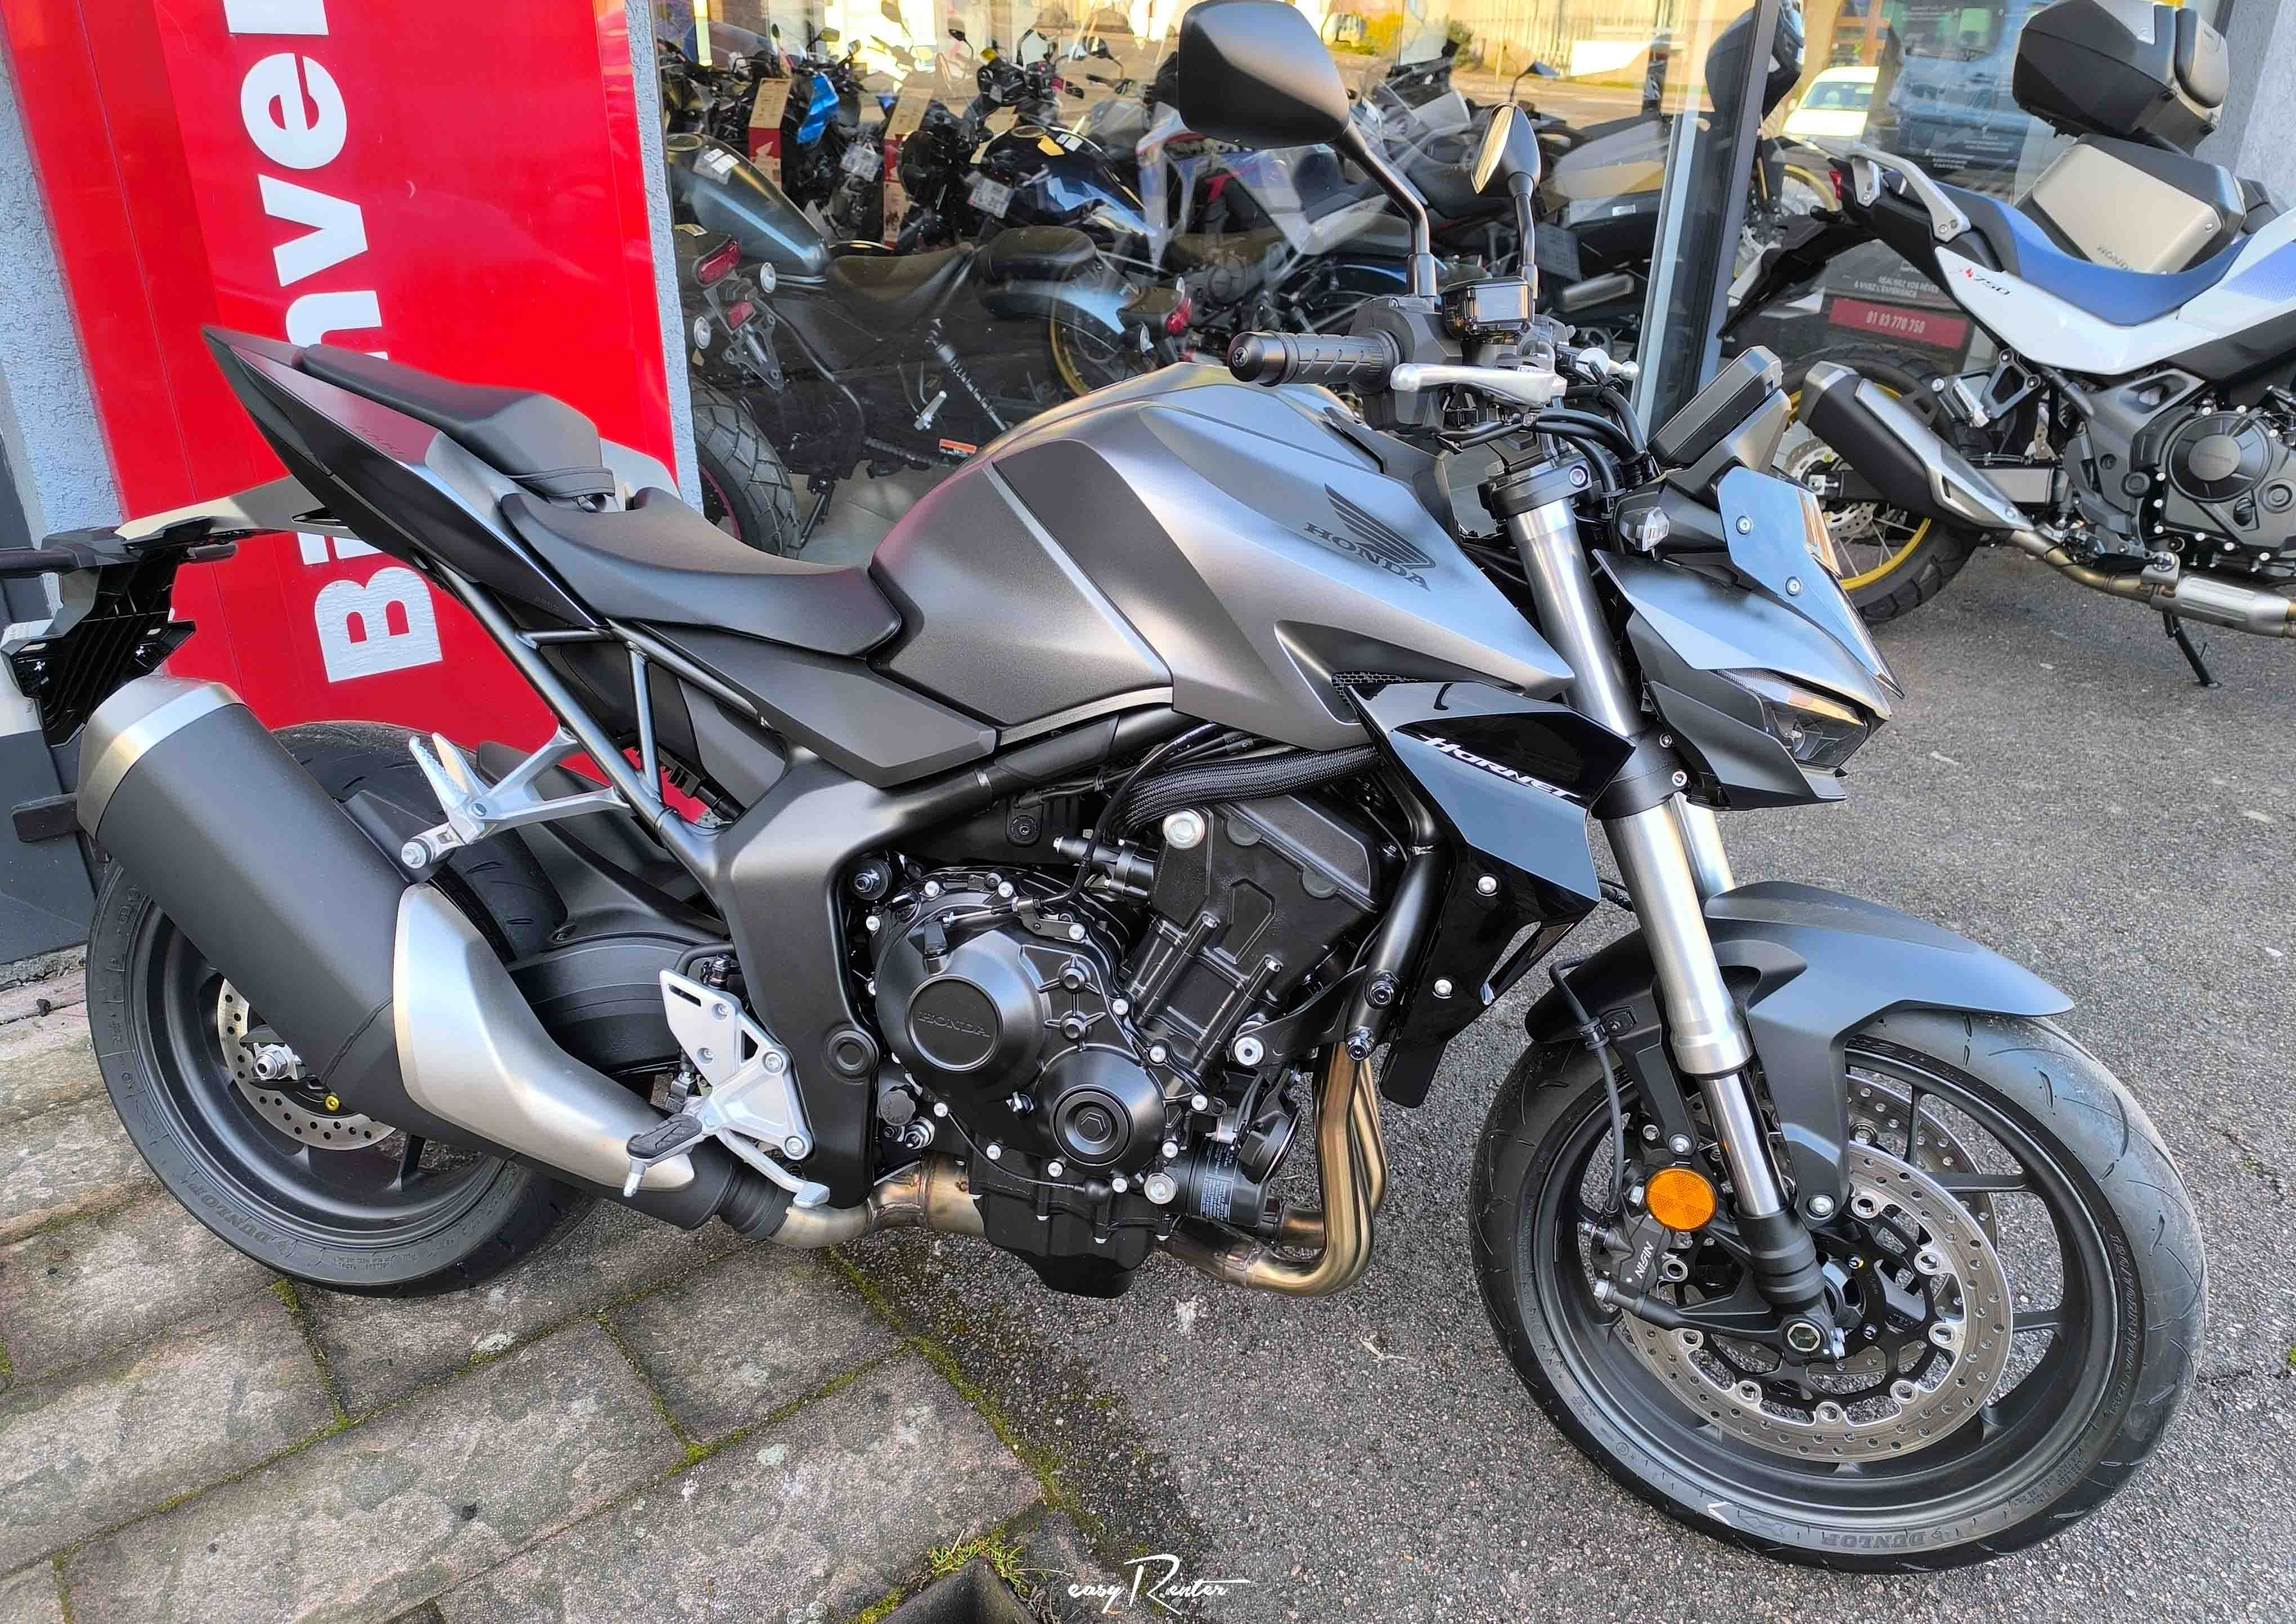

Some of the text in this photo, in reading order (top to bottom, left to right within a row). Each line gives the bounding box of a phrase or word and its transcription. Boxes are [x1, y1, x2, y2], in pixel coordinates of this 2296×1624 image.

[1303, 522, 1431, 592] HONDA
[918, 1011, 991, 1037] HONDA
[1819, 1532, 1927, 1550] DUNLOP
